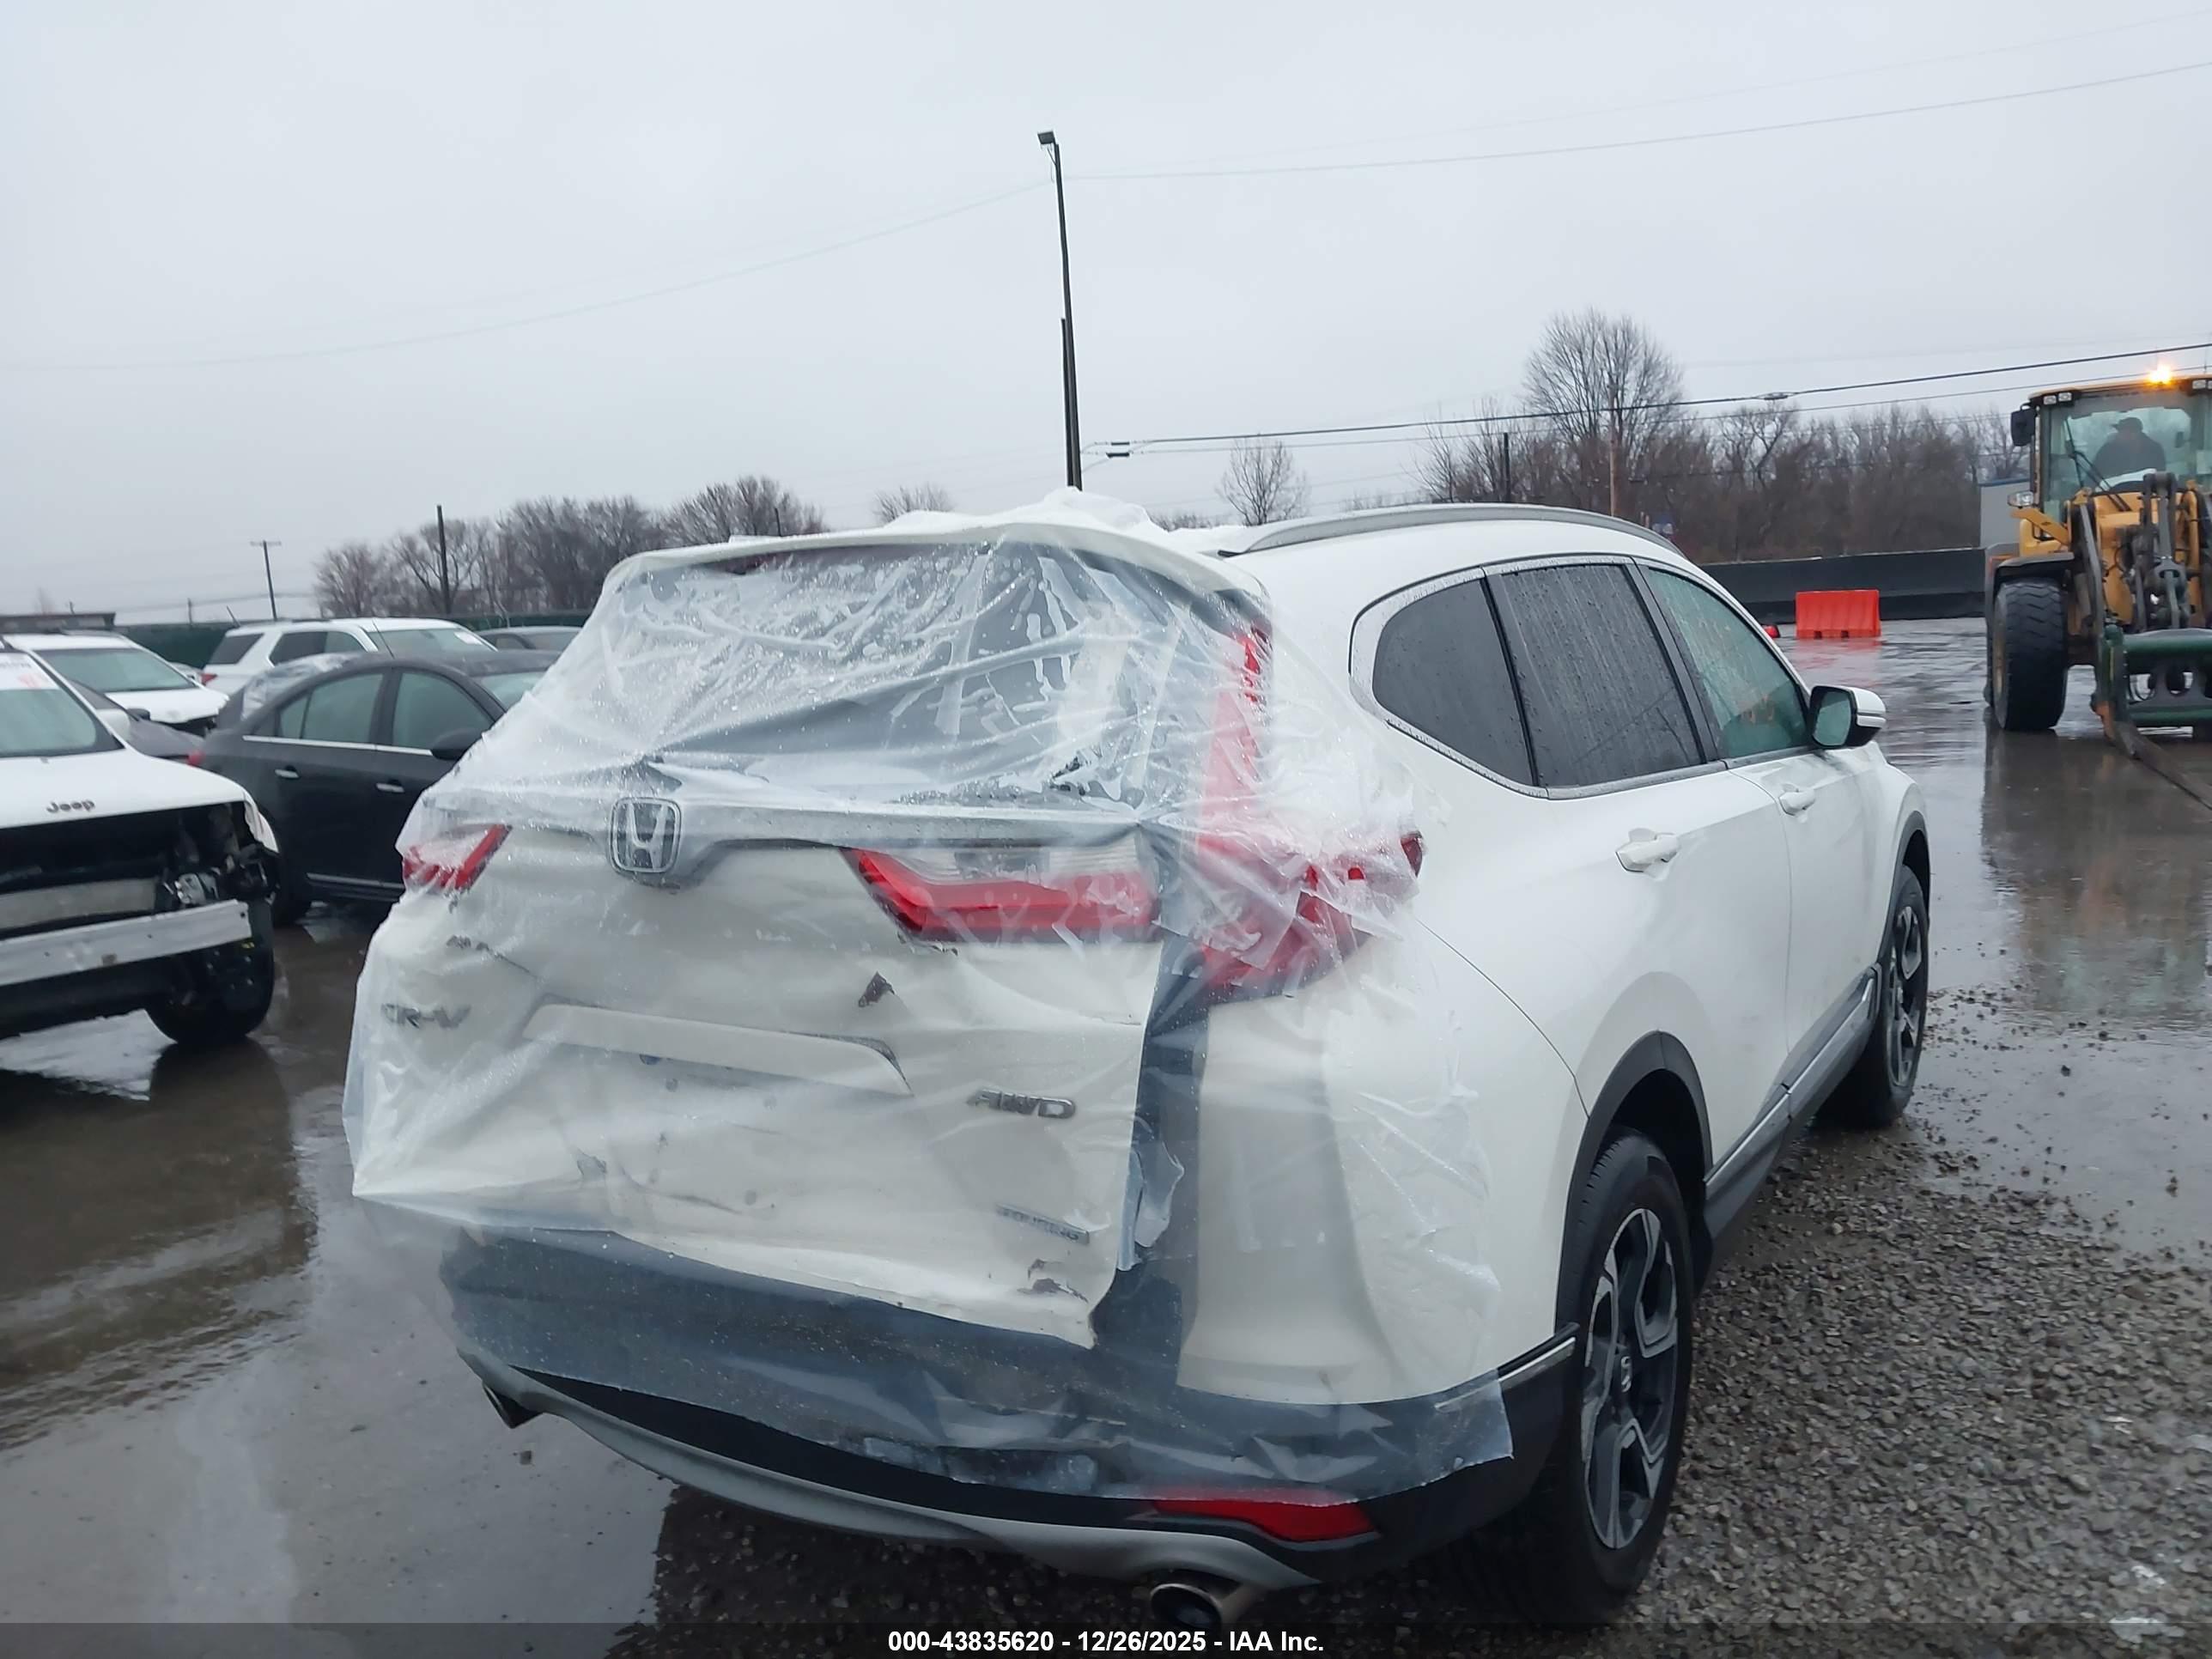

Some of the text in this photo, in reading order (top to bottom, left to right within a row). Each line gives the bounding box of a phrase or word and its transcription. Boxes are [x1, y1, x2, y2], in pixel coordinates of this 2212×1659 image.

[46, 799, 95, 814] Jeep
[380, 1002, 471, 1029] CR-V
[965, 1088, 1075, 1119] AWD
